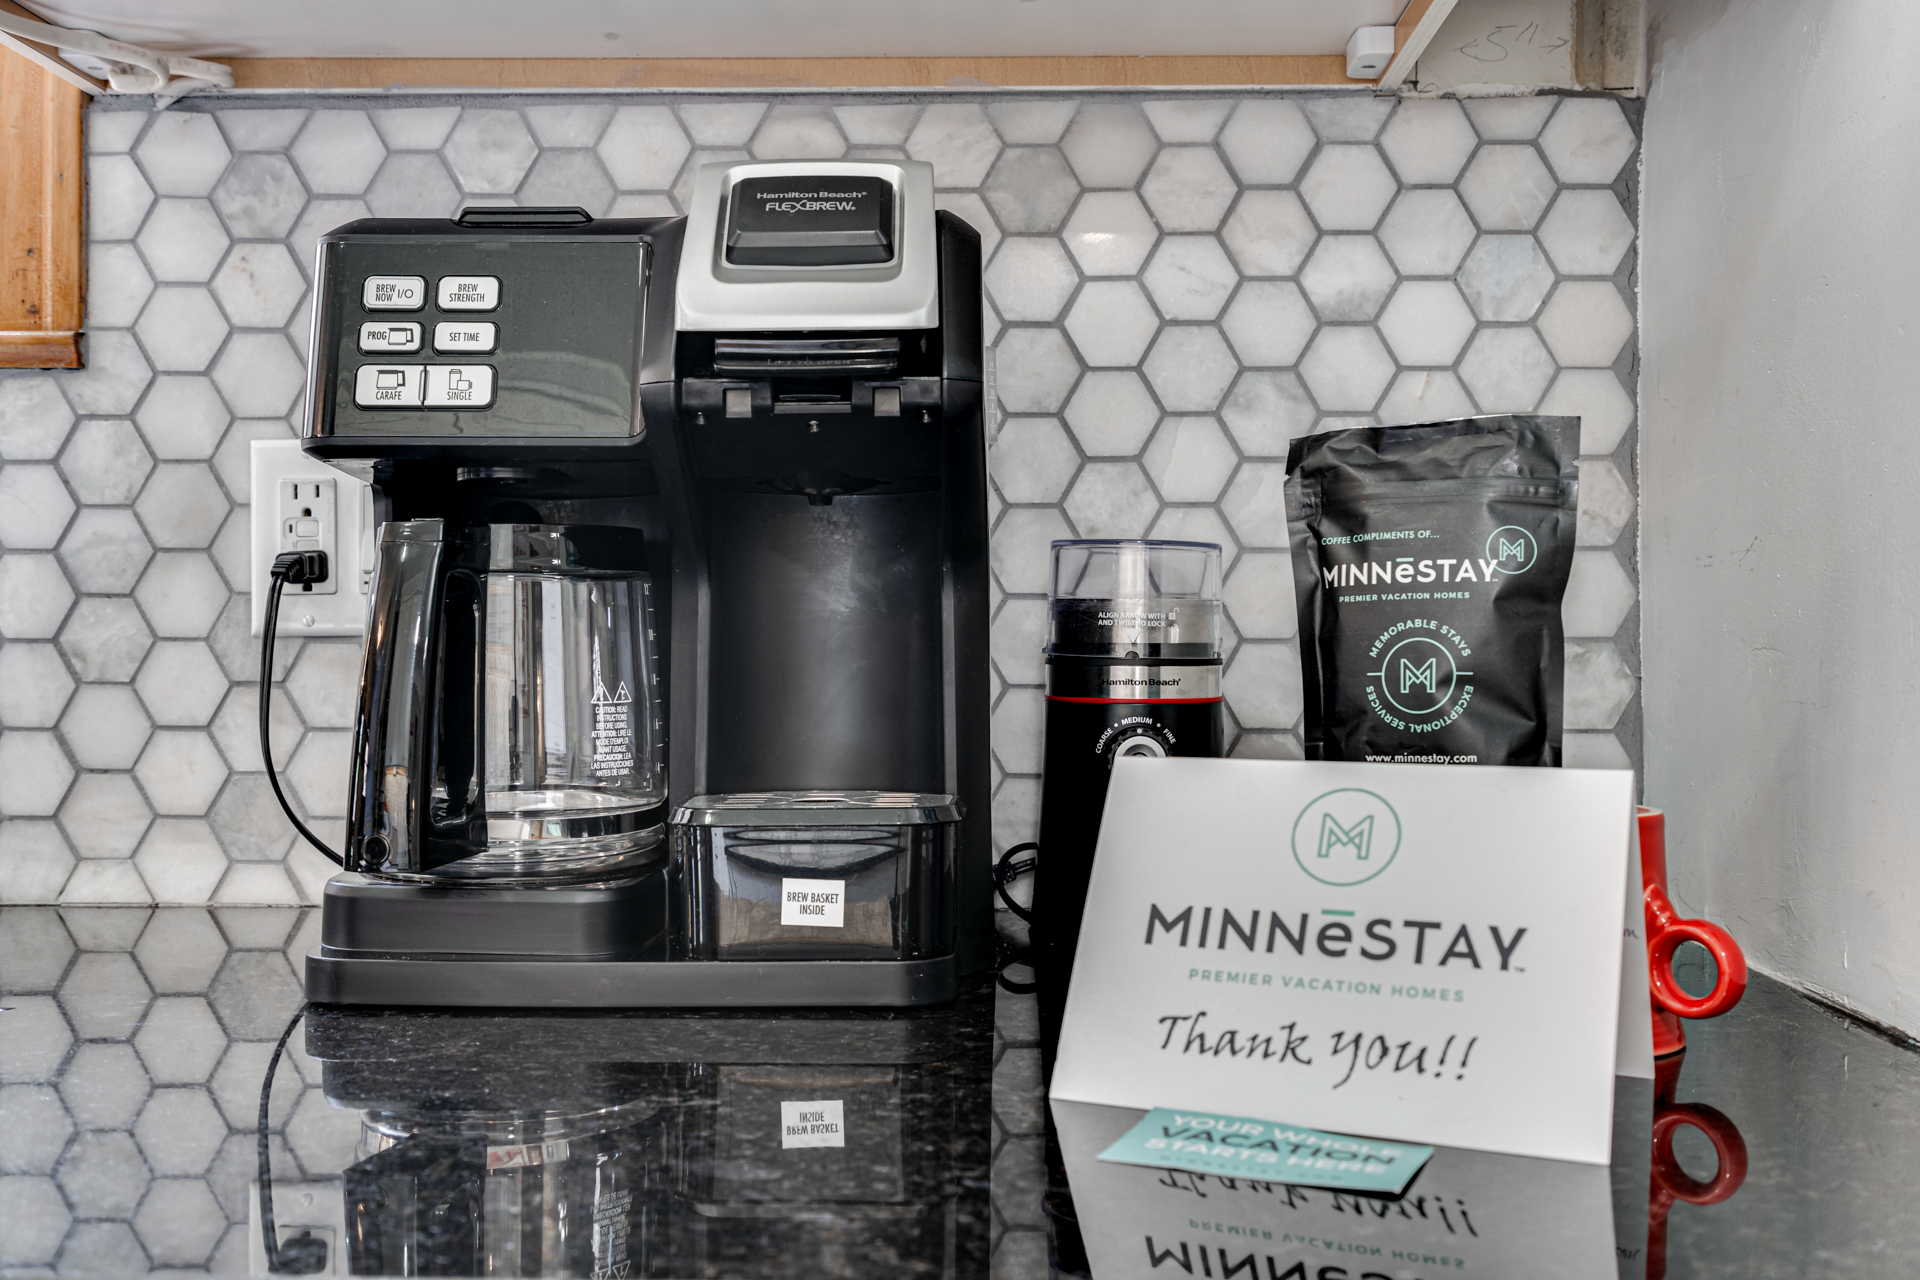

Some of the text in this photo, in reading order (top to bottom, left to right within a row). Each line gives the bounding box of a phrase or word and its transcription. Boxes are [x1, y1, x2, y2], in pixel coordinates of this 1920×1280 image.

[757, 191, 817, 199] Hamilton
[376, 284, 396, 292] BREW
[458, 284, 478, 292] BREW
[376, 293, 393, 302] NOW
[449, 293, 485, 302] STRENGTH
[367, 331, 387, 340] PROG
[449, 332, 480, 342] SET TIME
[375, 391, 402, 400] CARAFE
[447, 391, 472, 400] SINGLE
[1321, 535, 1351, 546] COFFEE
[1353, 530, 1415, 543] COMPLIMENTS
[1339, 591, 1470, 603] PREMIER VACATION HOMES
[1098, 611, 1119, 619] ALIGN
[1369, 618, 1472, 658] MEMORABLE STAYS
[1101, 678, 1147, 686] Hamilton
[617, 705, 628, 713] READ
[1366, 684, 1474, 733] EXCEPTIONAL SERVICES
[596, 713, 628, 722] INTRUCTIONS
[1121, 716, 1153, 726] MEDIUM
[1096, 727, 1114, 754] COARSE
[1163, 728, 1177, 745] FINE
[624, 752, 632, 760] LEA
[1365, 752, 1478, 765] www.minnestay.com
[591, 762, 601, 770] LAS
[787, 891, 839, 904] BREW BASKET
[799, 904, 825, 916] INSIDE
[1189, 968, 1465, 1003] PREMIER VACATION HOMES
[1158, 1011, 1479, 1090] Thank you!!
[1173, 1114, 1402, 1157] YOUR WHOLE
[1162, 1126, 1396, 1165] VACATION
[1144, 1138, 1279, 1164] STARTS
[1287, 1155, 1387, 1175] HERE
